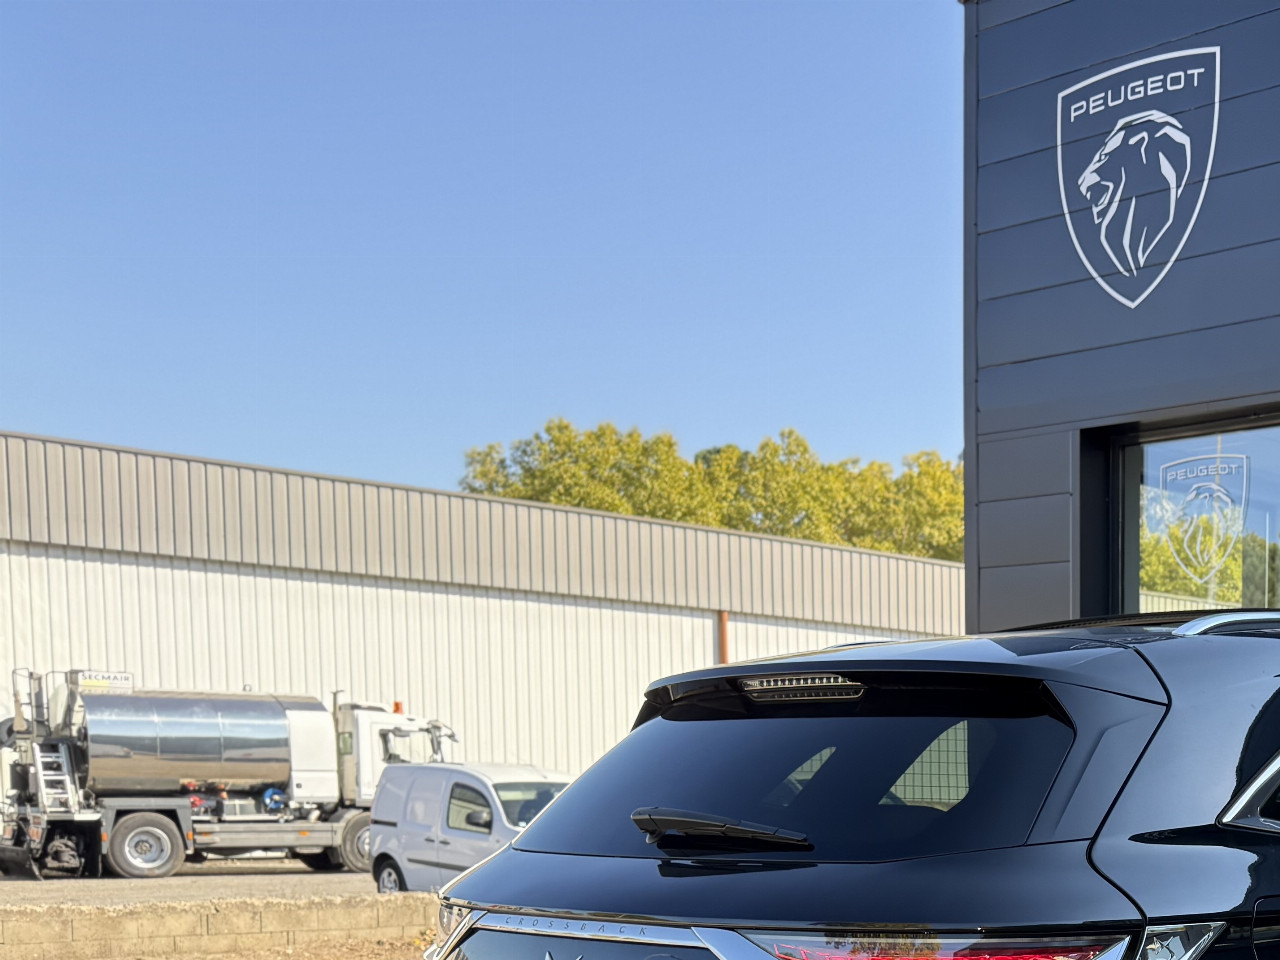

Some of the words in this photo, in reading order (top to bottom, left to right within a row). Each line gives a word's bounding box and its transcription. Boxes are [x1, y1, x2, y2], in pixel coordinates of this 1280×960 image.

[1070, 68, 1206, 123] PEUGEOT
[1166, 463, 1239, 482] PEUGEOT
[504, 915, 648, 936] CROSSBACK
